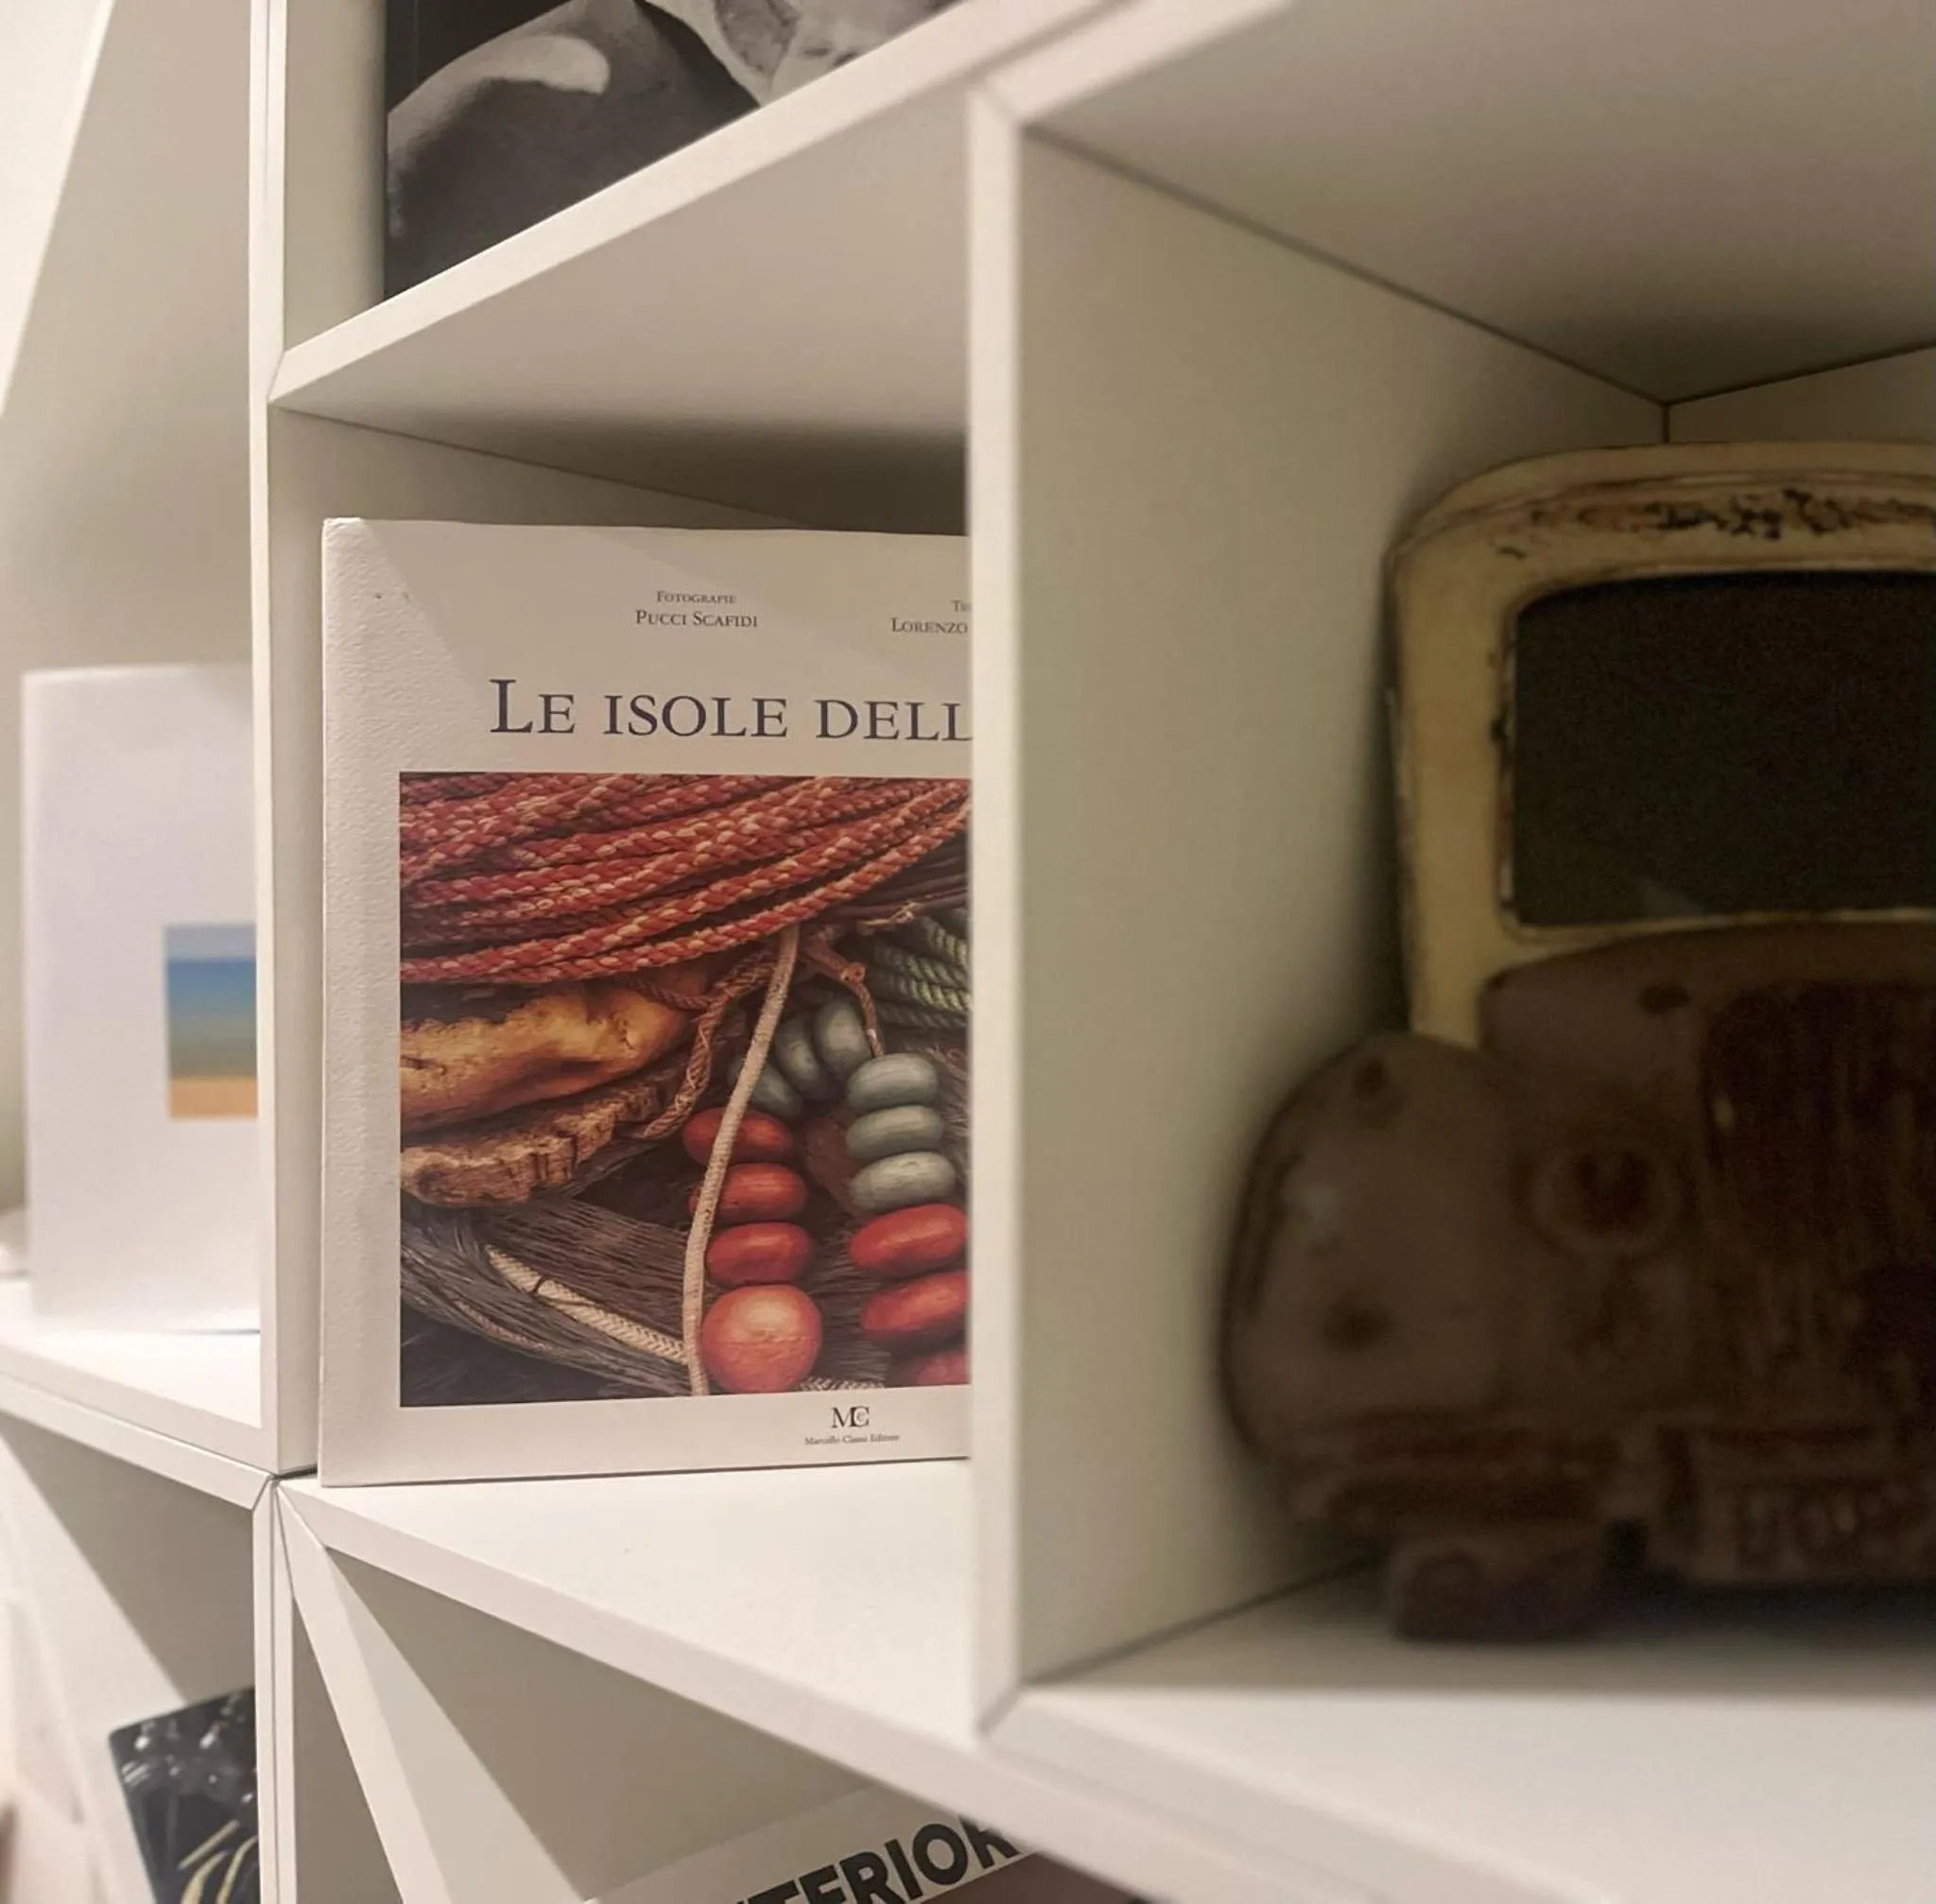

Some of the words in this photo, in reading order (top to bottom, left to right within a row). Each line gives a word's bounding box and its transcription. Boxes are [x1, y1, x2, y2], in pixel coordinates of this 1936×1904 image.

[635, 609, 686, 626] PUCCI
[693, 610, 758, 628] SCAFIDI
[890, 616, 968, 634] LORENZO
[489, 679, 575, 735] LE
[603, 694, 788, 737] ISOLE
